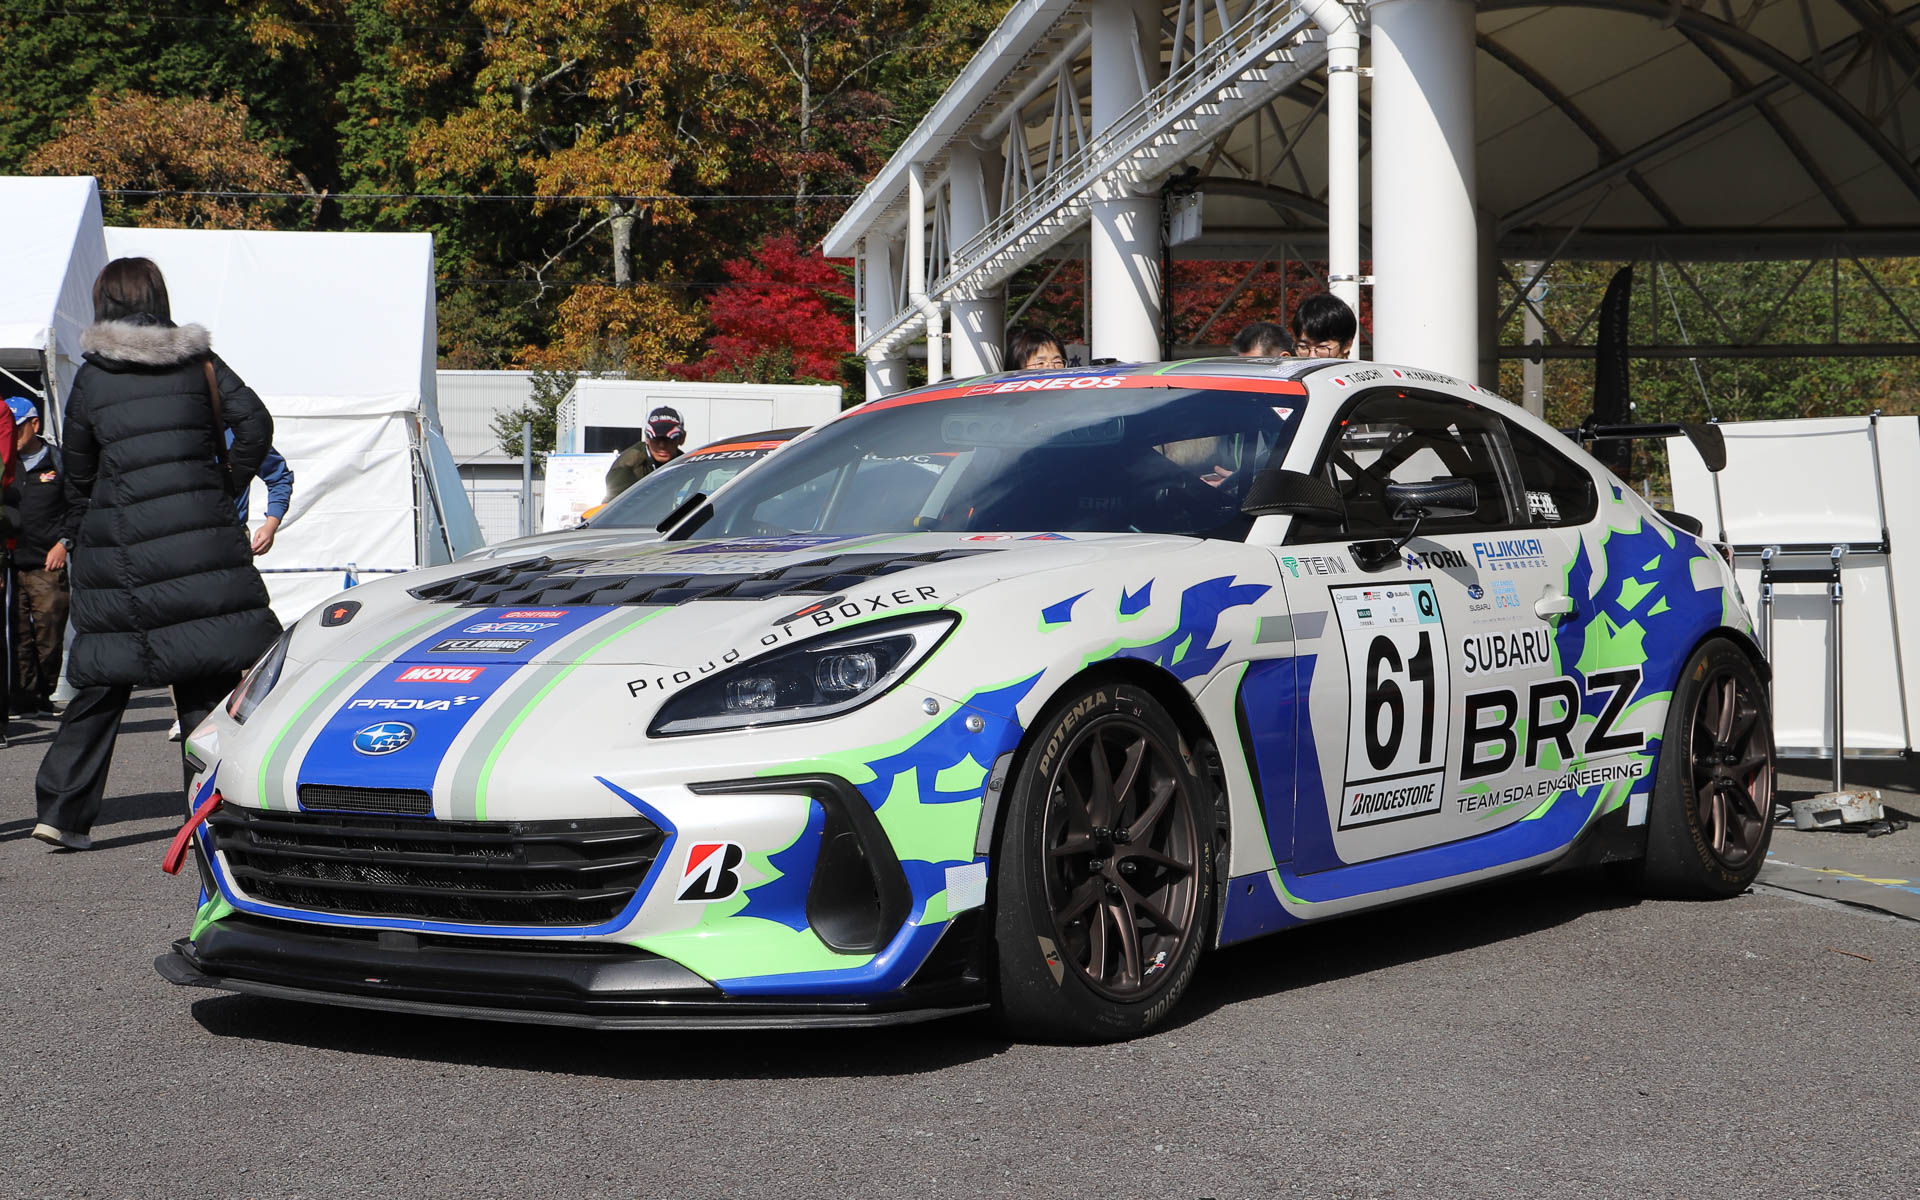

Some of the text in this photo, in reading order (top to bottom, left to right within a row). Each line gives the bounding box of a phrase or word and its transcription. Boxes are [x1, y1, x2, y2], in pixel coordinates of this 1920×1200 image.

[992, 376, 1127, 393] ENEOS
[1345, 368, 1383, 384] T.IGUCHI
[685, 450, 756, 463] MAZDA
[1298, 556, 1348, 576] TEIN
[1418, 550, 1468, 569] TORII
[1472, 538, 1544, 568] FUJIKIKAI
[1418, 590, 1435, 617] Q
[462, 622, 560, 634] EXEDY
[627, 586, 940, 698] Proud of BOXER
[1464, 629, 1550, 674] SUBARU
[401, 668, 478, 681] MOTUL
[348, 698, 450, 711] PROVA
[1364, 630, 1435, 771] 61
[1039, 691, 1108, 778] POTENZA
[1460, 669, 1644, 781] BRZ
[1350, 783, 1436, 817] BRIDGESTONE
[1457, 763, 1643, 813] TEAM SDA ENGINEERING
[1143, 924, 1206, 1028] BRIDGESTONE
